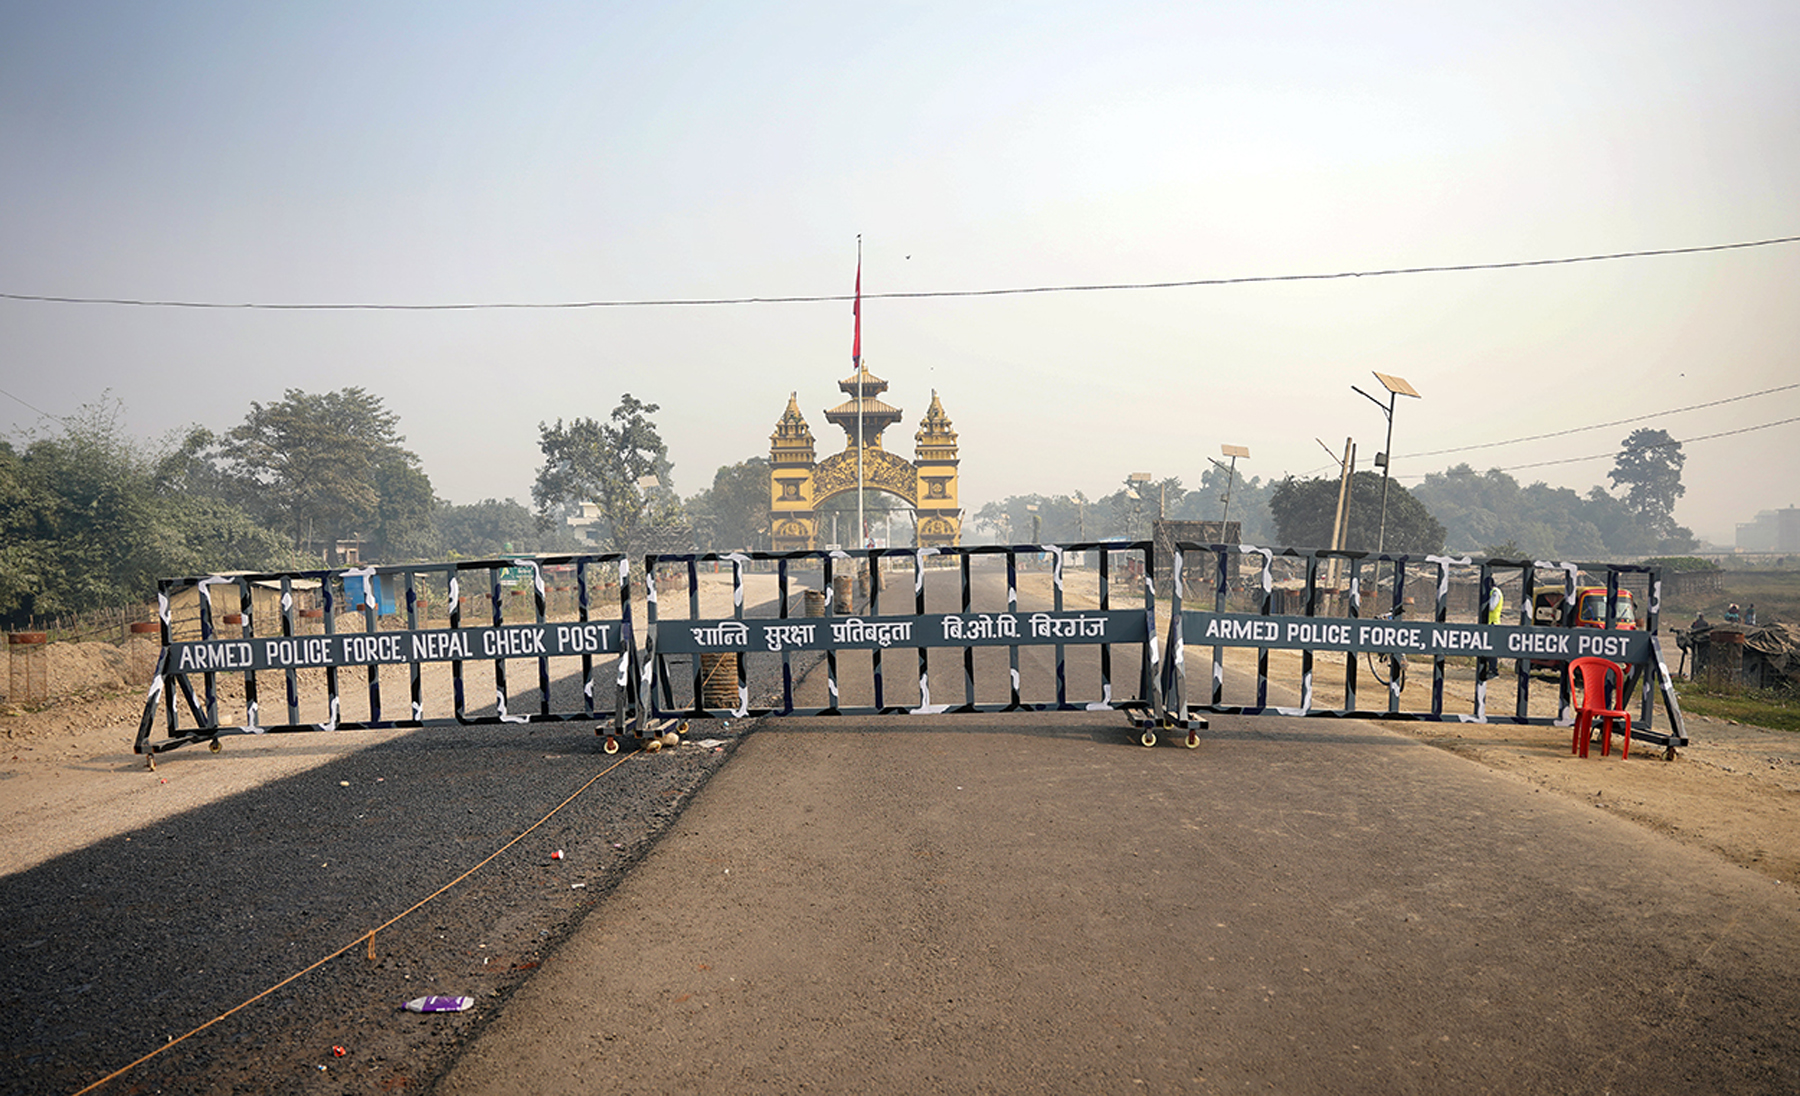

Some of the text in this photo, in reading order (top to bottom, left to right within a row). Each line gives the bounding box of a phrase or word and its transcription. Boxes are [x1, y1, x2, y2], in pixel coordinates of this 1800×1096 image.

[178, 625, 610, 670] ARMED POLICE FORCE, NEPAL CHECK POST
[690, 621, 750, 646] शान्ति
[763, 624, 816, 651] सुरक्षा
[1028, 613, 1109, 638] बिरगंज
[1205, 619, 1630, 657] ARMED POLICE FORCE, NEPAL CHECK POST
